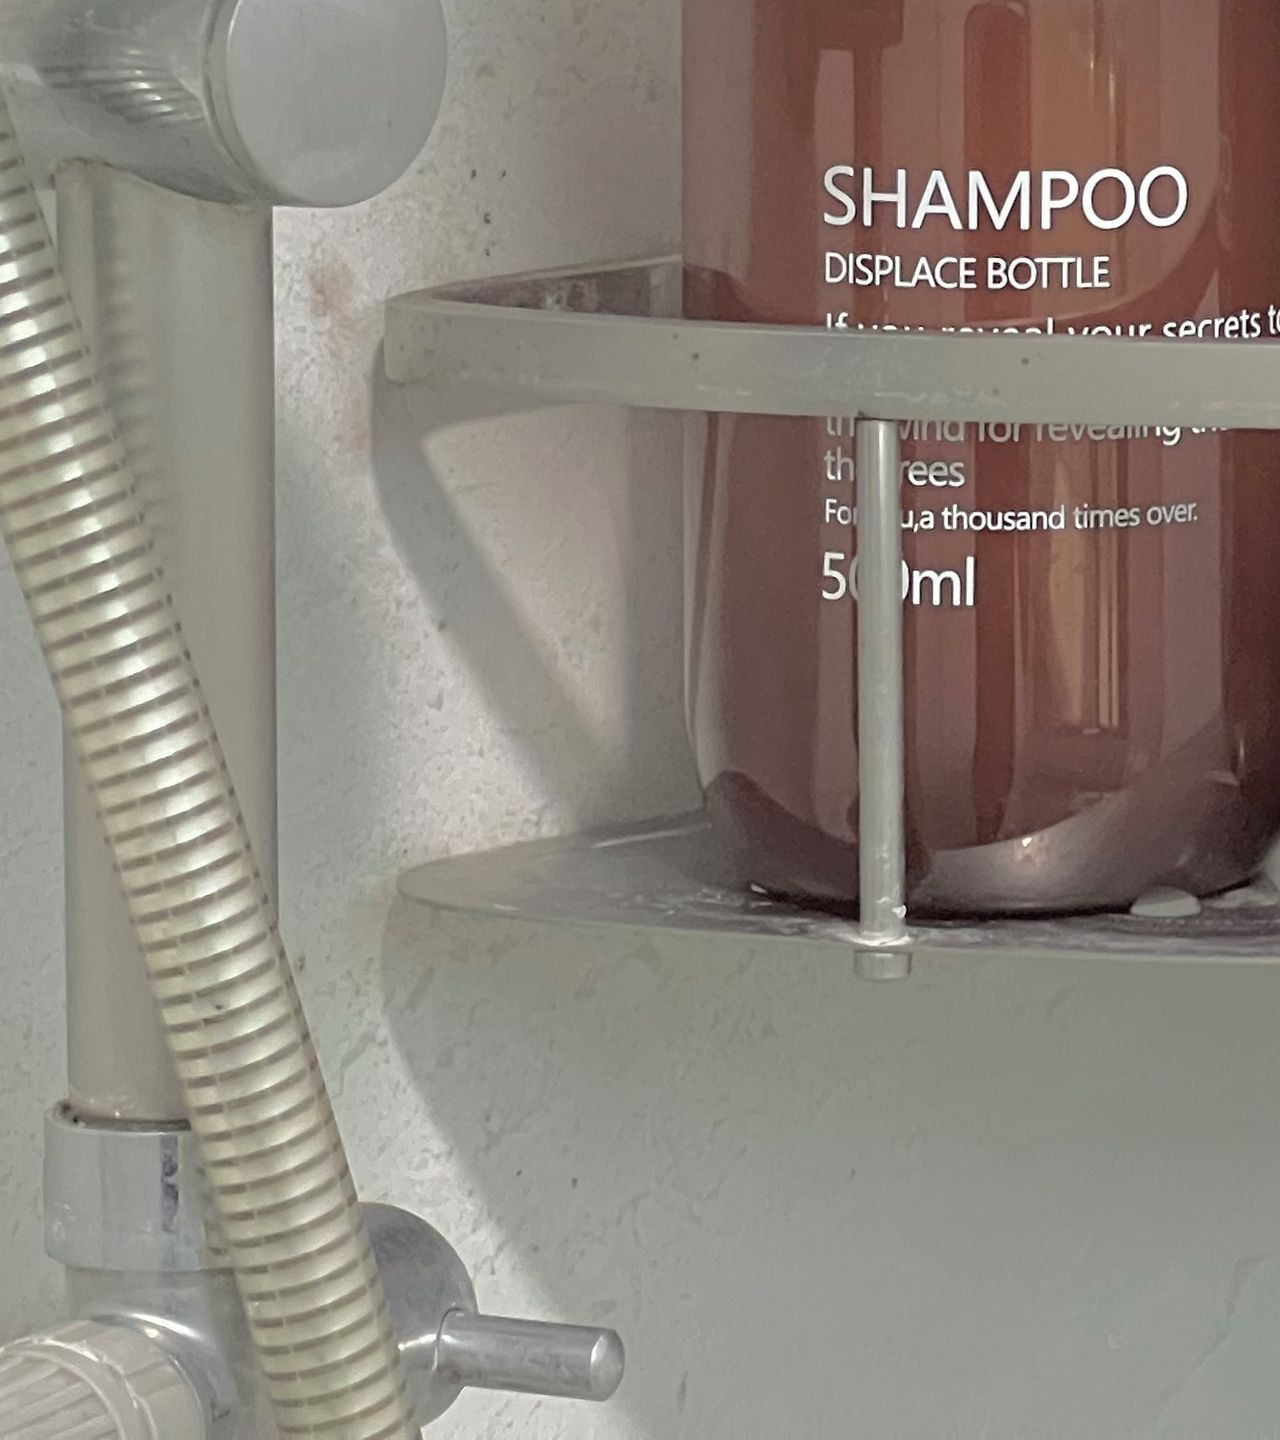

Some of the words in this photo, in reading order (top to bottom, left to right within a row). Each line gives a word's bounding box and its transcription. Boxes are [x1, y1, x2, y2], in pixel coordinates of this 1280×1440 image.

[822, 164, 1190, 230] SHAMPOO
[824, 252, 976, 289] DISPLACE
[986, 255, 1111, 289] BOTTLE
[824, 446, 856, 481] th
[900, 460, 965, 487] rees
[941, 504, 1066, 531] thousand
[1073, 500, 1141, 527] times
[1146, 496, 1198, 524] over.
[822, 551, 975, 606] 5ml
